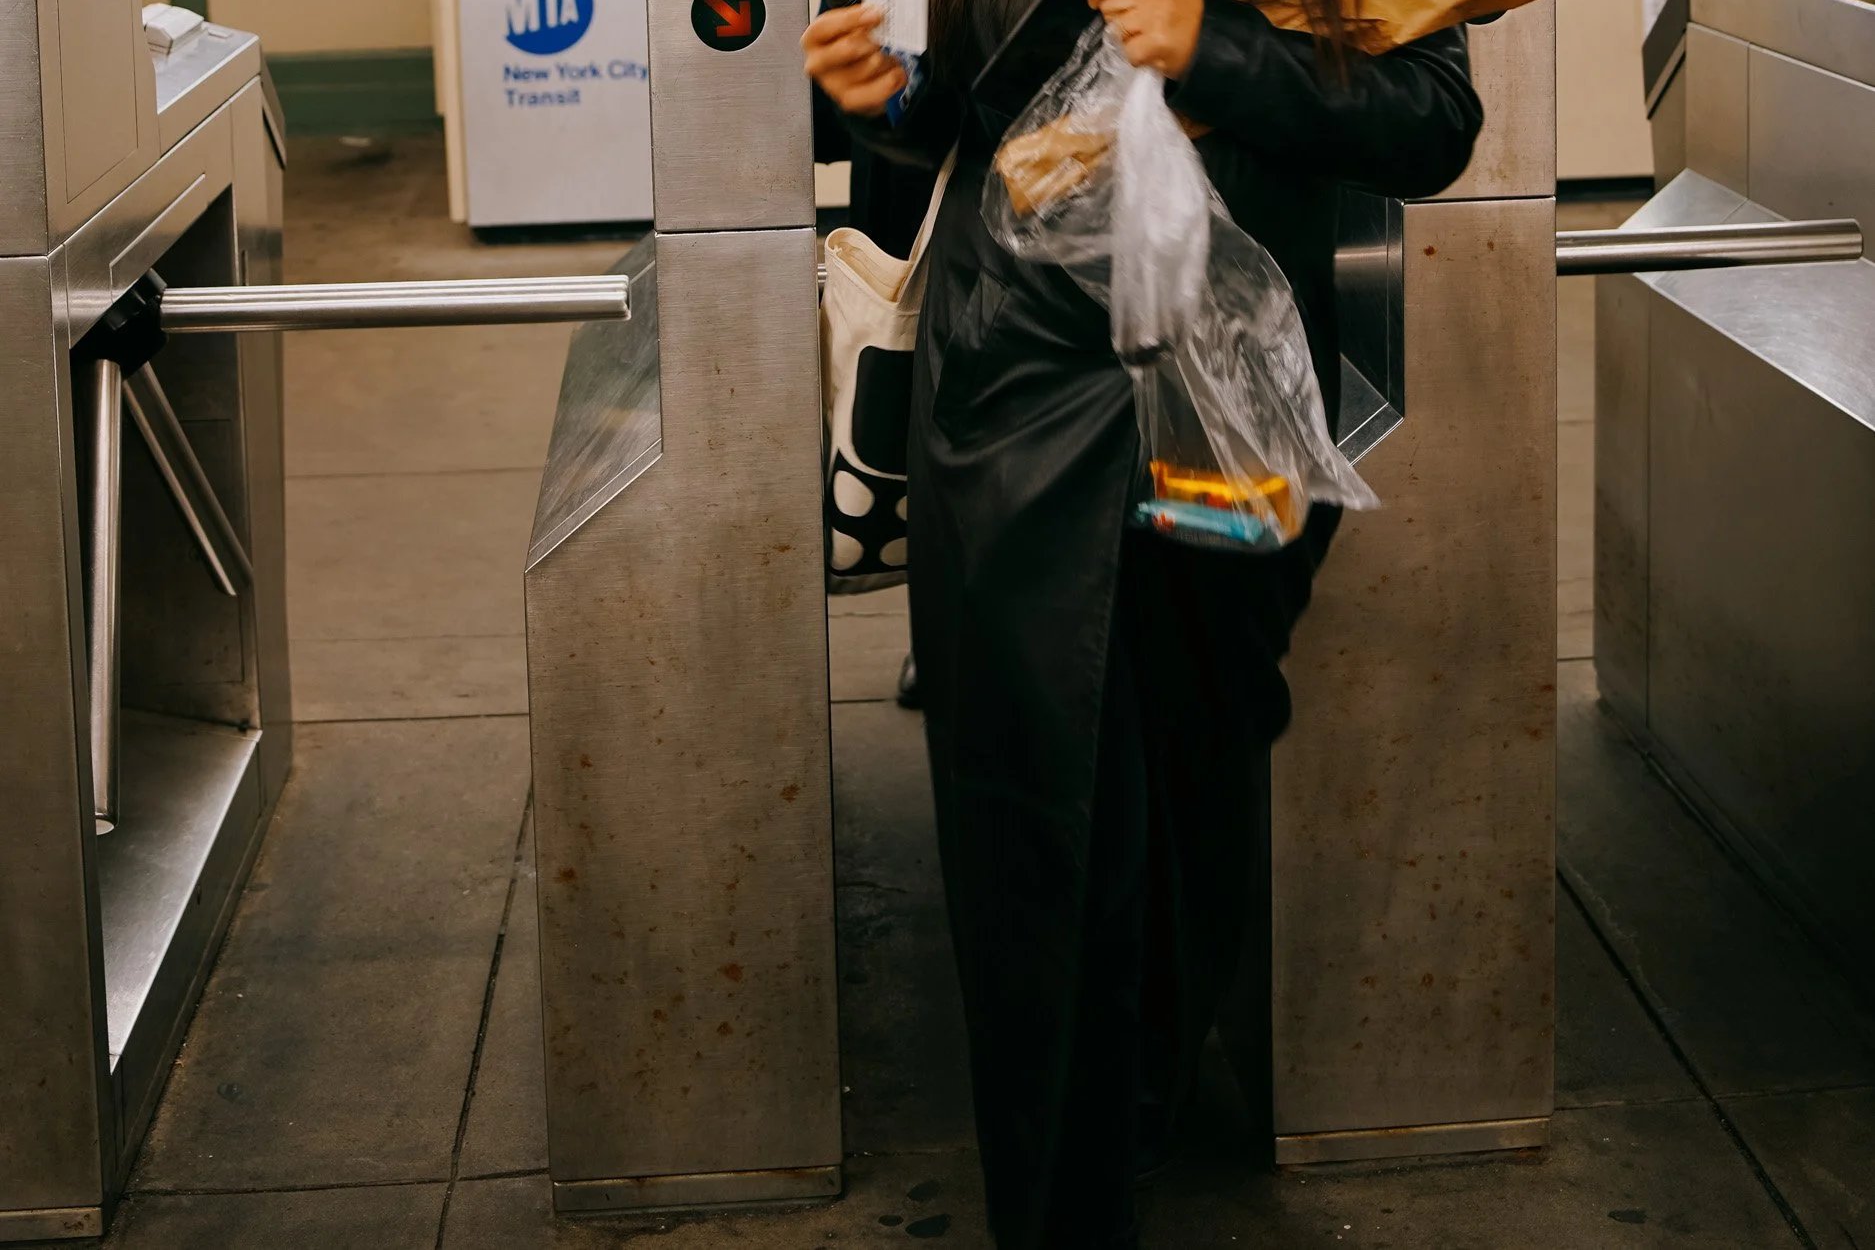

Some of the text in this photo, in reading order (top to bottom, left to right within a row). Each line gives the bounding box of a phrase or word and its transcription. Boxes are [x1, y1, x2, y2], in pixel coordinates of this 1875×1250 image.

[504, 59, 648, 82] New York City
[506, 87, 581, 107] Transit
